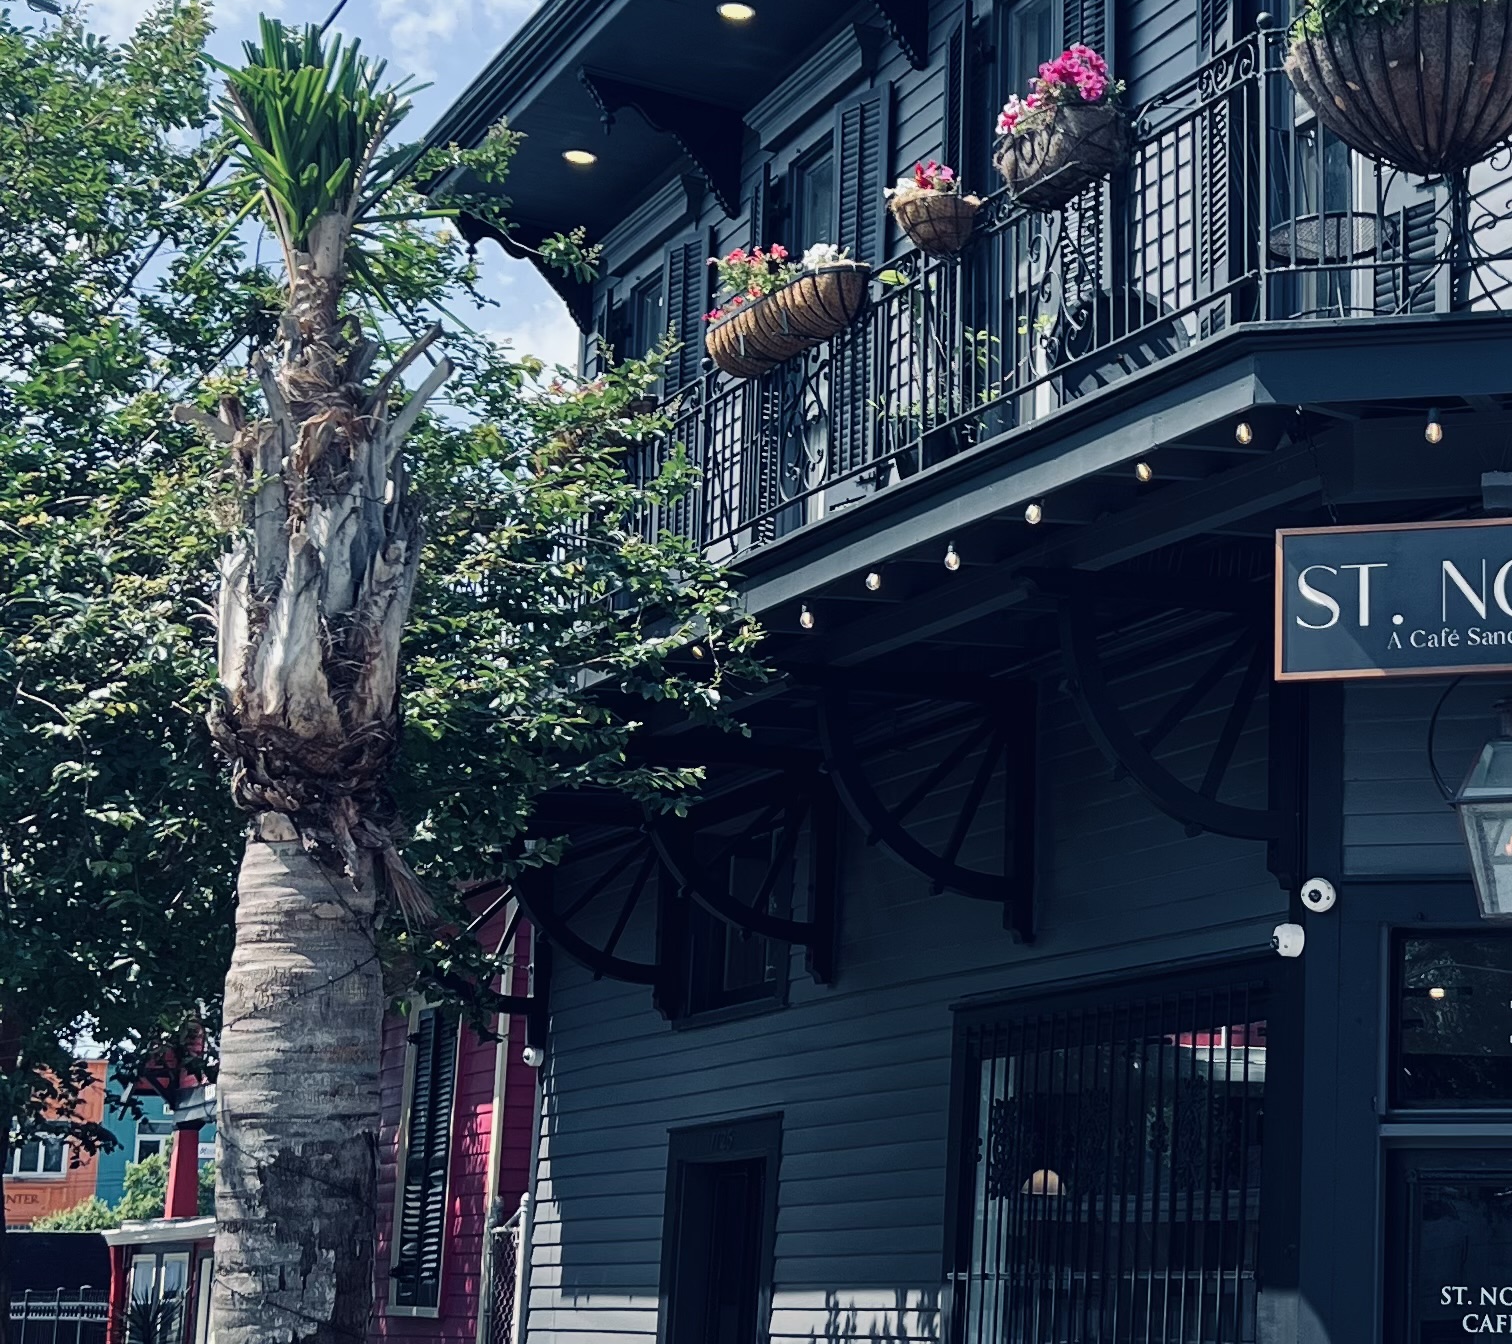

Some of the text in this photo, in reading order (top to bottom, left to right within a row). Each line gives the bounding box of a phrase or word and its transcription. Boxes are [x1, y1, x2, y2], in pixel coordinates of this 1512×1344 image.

[1296, 563, 1404, 630] ST.
[1387, 630, 1402, 650] A
[1409, 628, 1460, 649] Café
[5, 1193, 40, 1205] NTER
[1440, 1285, 1472, 1306] ST.
